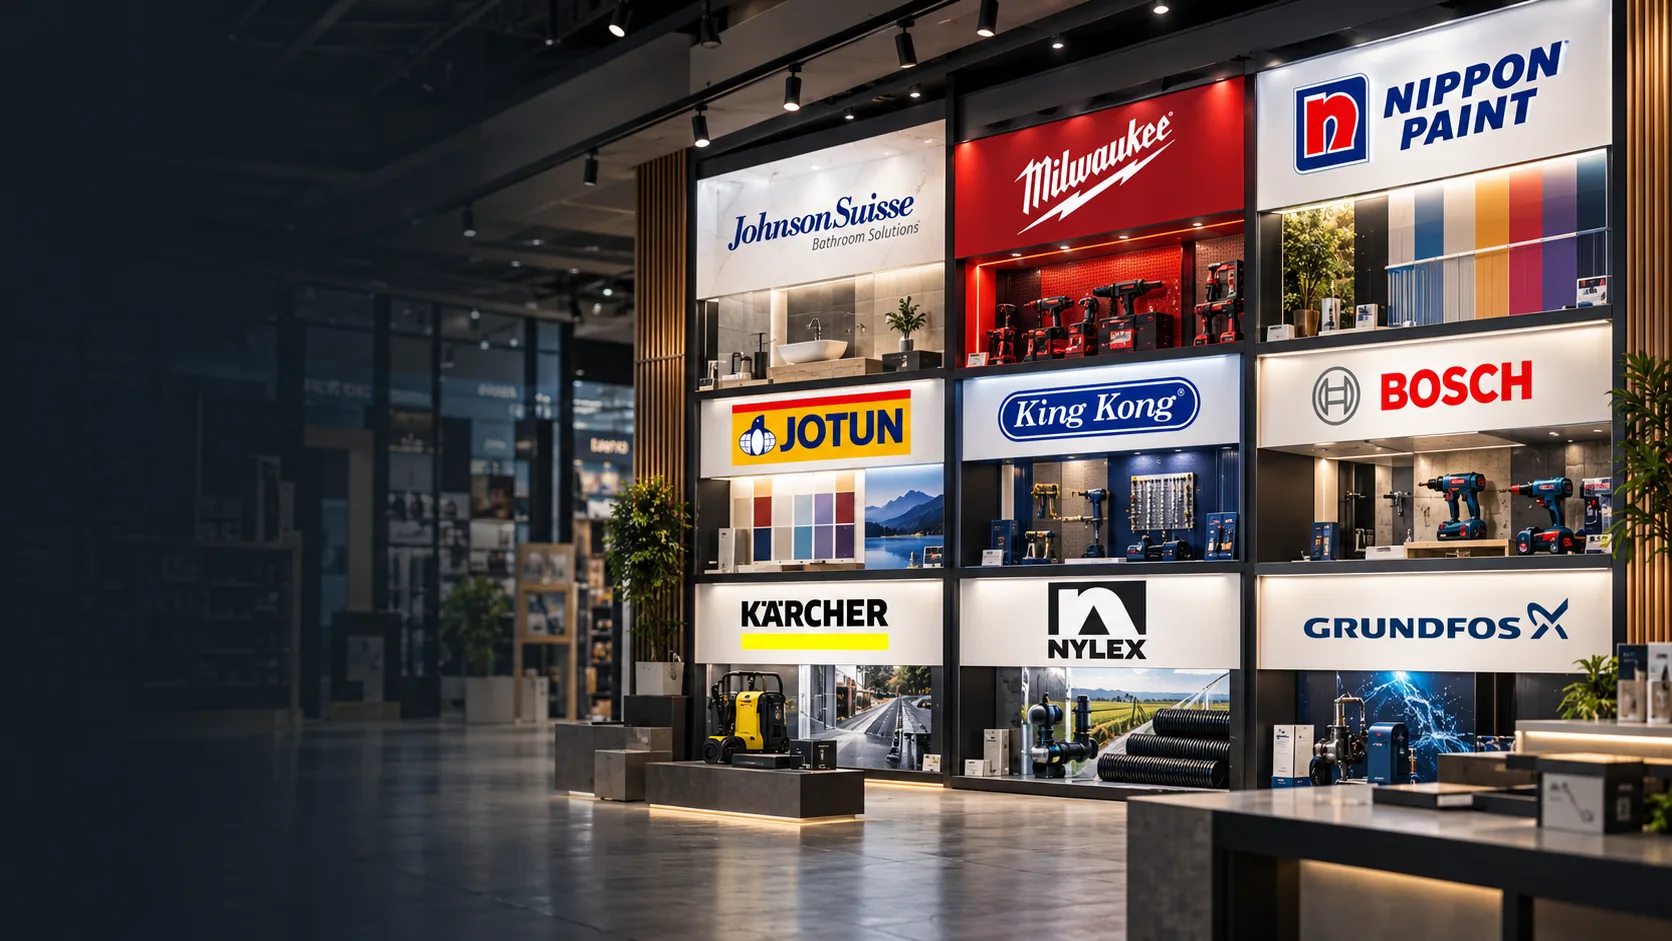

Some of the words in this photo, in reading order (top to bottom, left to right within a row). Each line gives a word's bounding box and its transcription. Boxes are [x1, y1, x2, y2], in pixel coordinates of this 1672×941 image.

[1383, 41, 1563, 119] NIPPON
[1400, 88, 1538, 151] PAINT
[1014, 115, 1173, 215] Milwaukee
[812, 233, 866, 251] Bathroom
[868, 222, 920, 242] Solutions
[1380, 360, 1533, 411] BOSCH
[779, 408, 904, 452] JOTUN
[1013, 399, 1087, 429] King
[741, 598, 889, 628] KÄRCHER
[1303, 616, 1521, 640] GRUNDFOS
[1048, 639, 1147, 660] NYLEX
